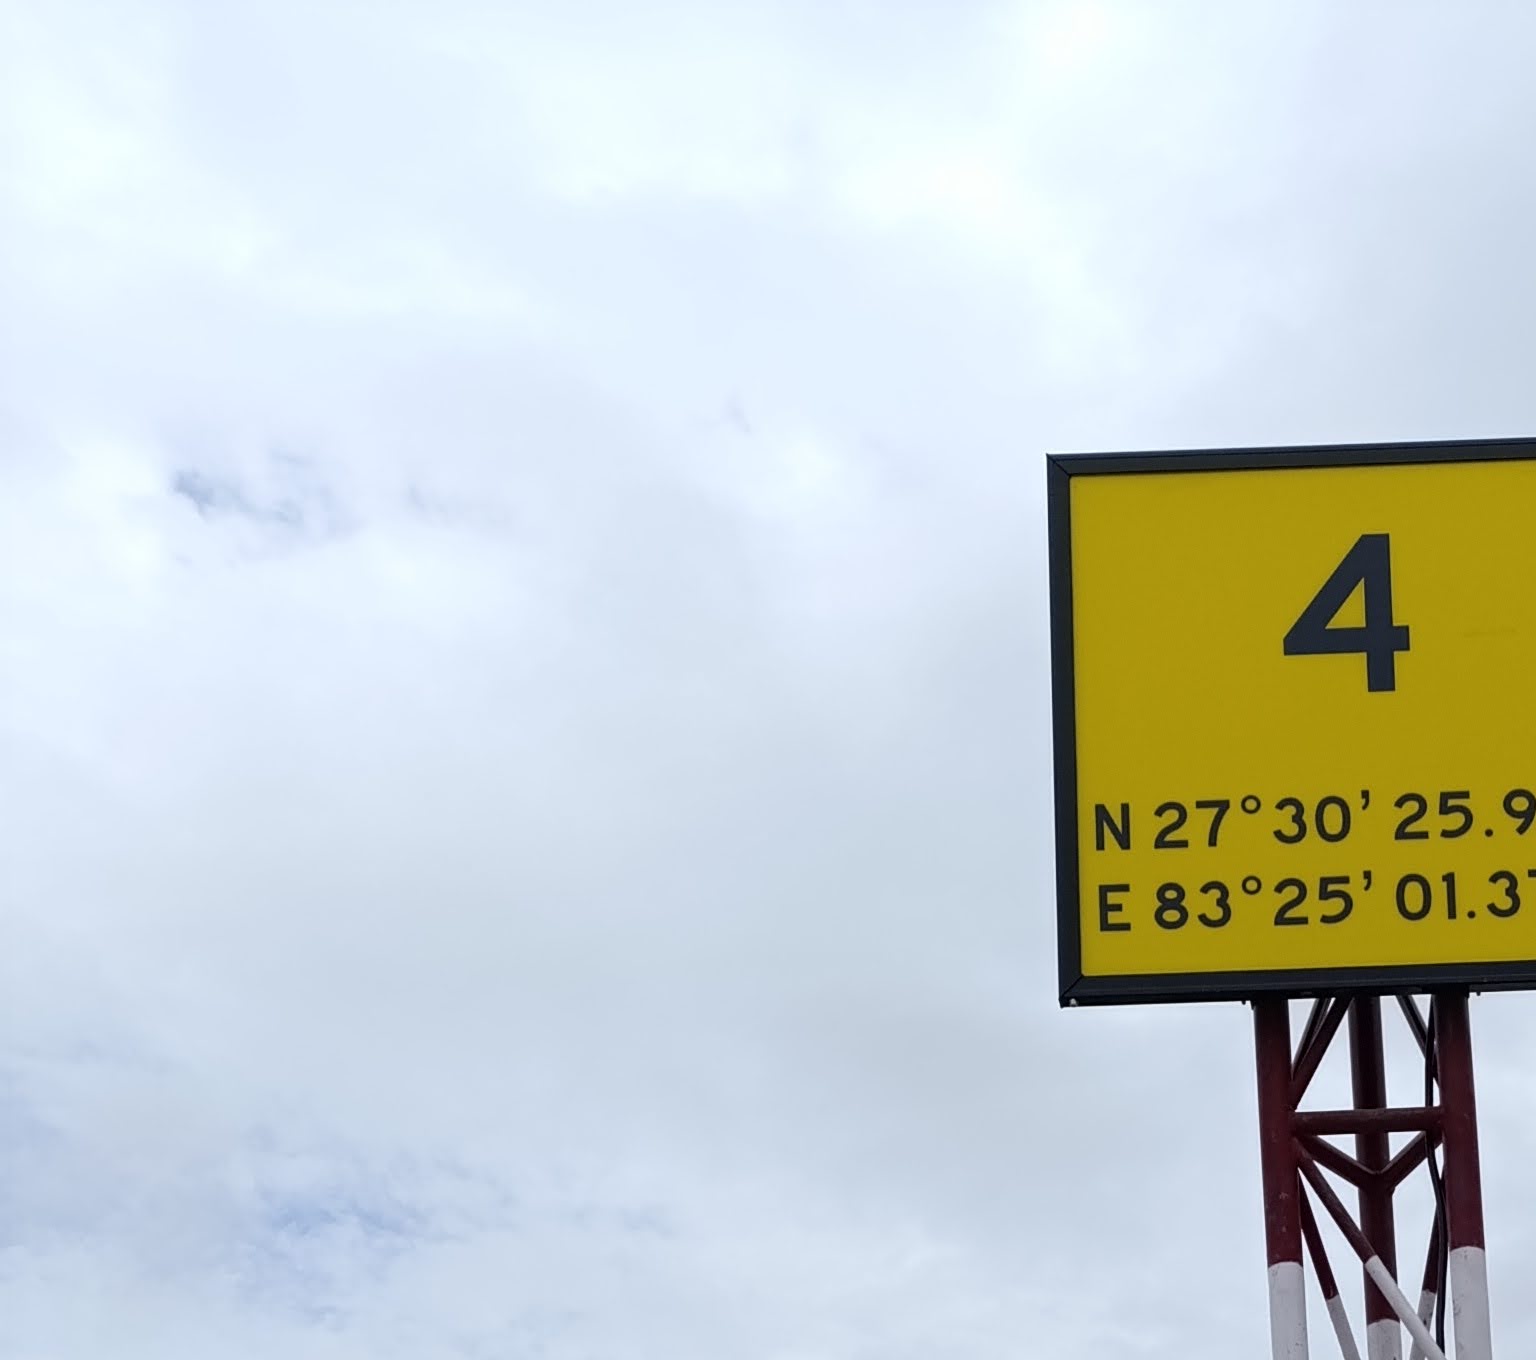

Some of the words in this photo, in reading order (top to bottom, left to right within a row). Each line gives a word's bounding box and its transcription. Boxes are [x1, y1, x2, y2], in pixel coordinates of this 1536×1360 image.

[1283, 533, 1410, 692] 4
[1095, 802, 1131, 851] N
[1099, 883, 1131, 932] E
